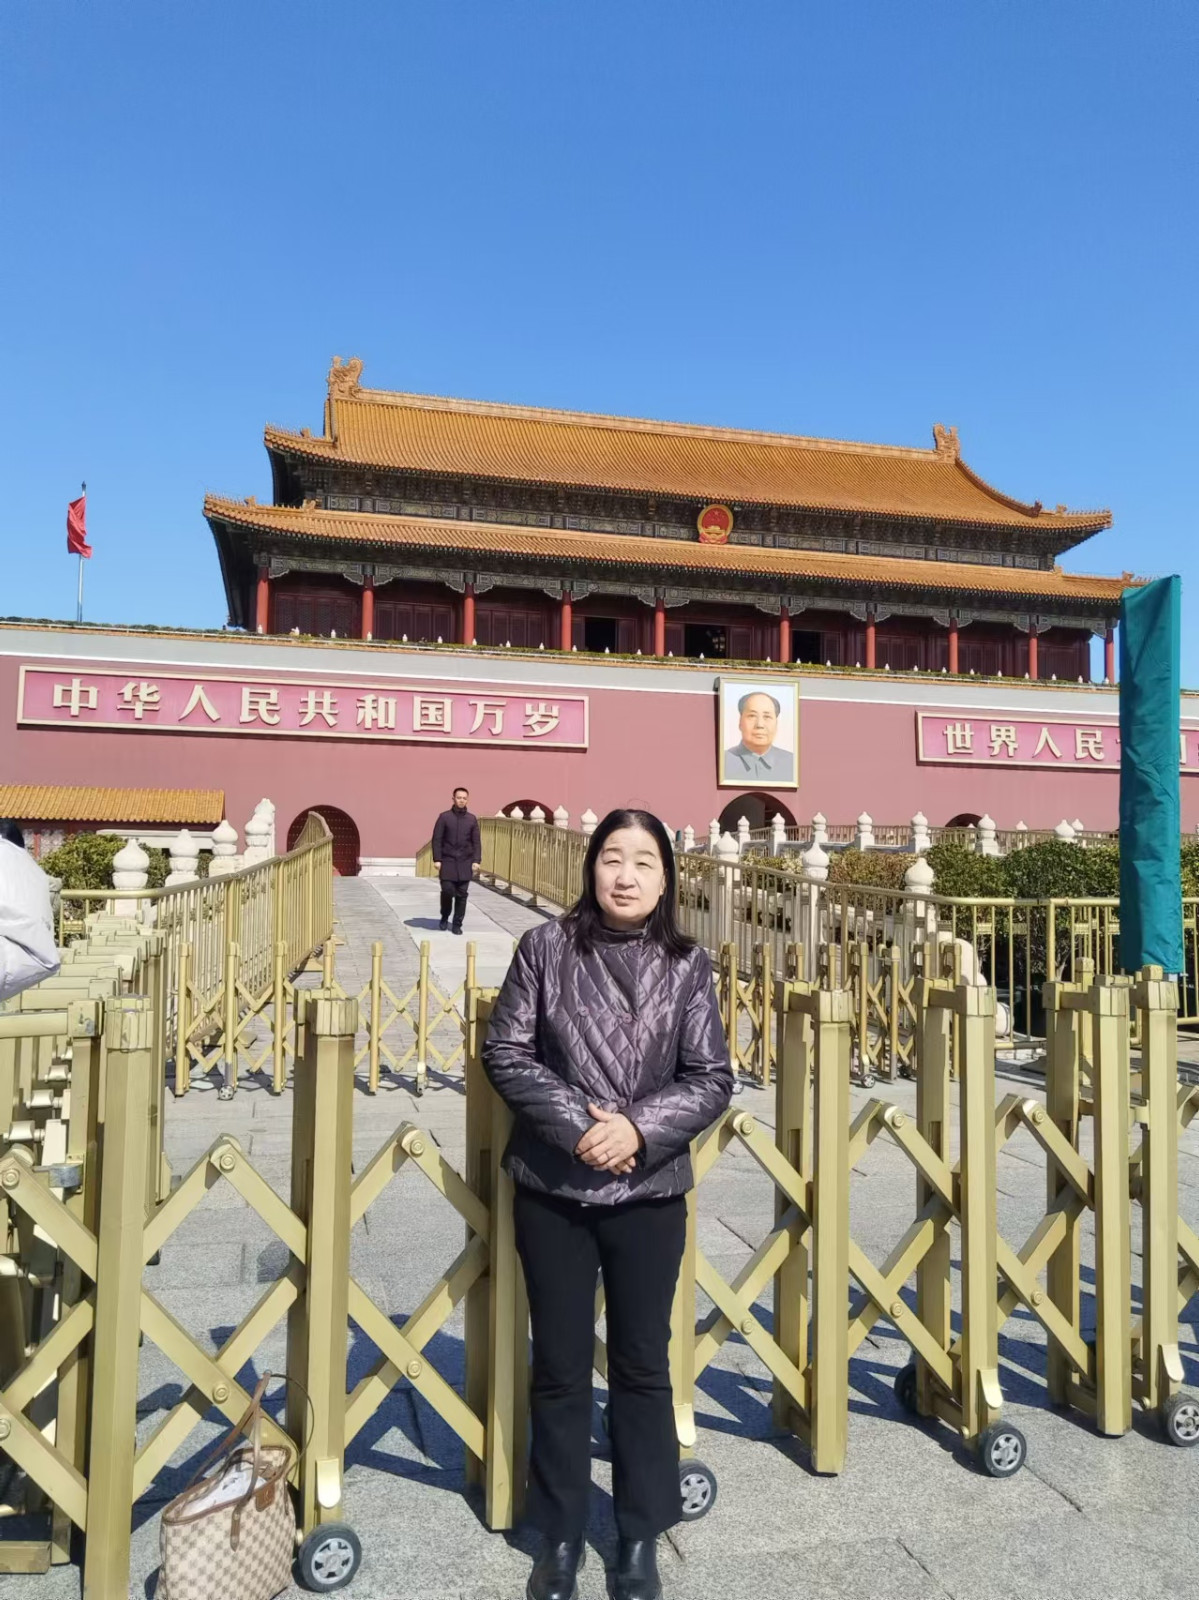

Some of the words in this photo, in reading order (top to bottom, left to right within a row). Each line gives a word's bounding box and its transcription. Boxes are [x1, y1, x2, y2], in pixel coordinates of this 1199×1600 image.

[52, 678, 562, 738] 中华人民共和国万岁
[942, 722, 1187, 765] 世界人民
